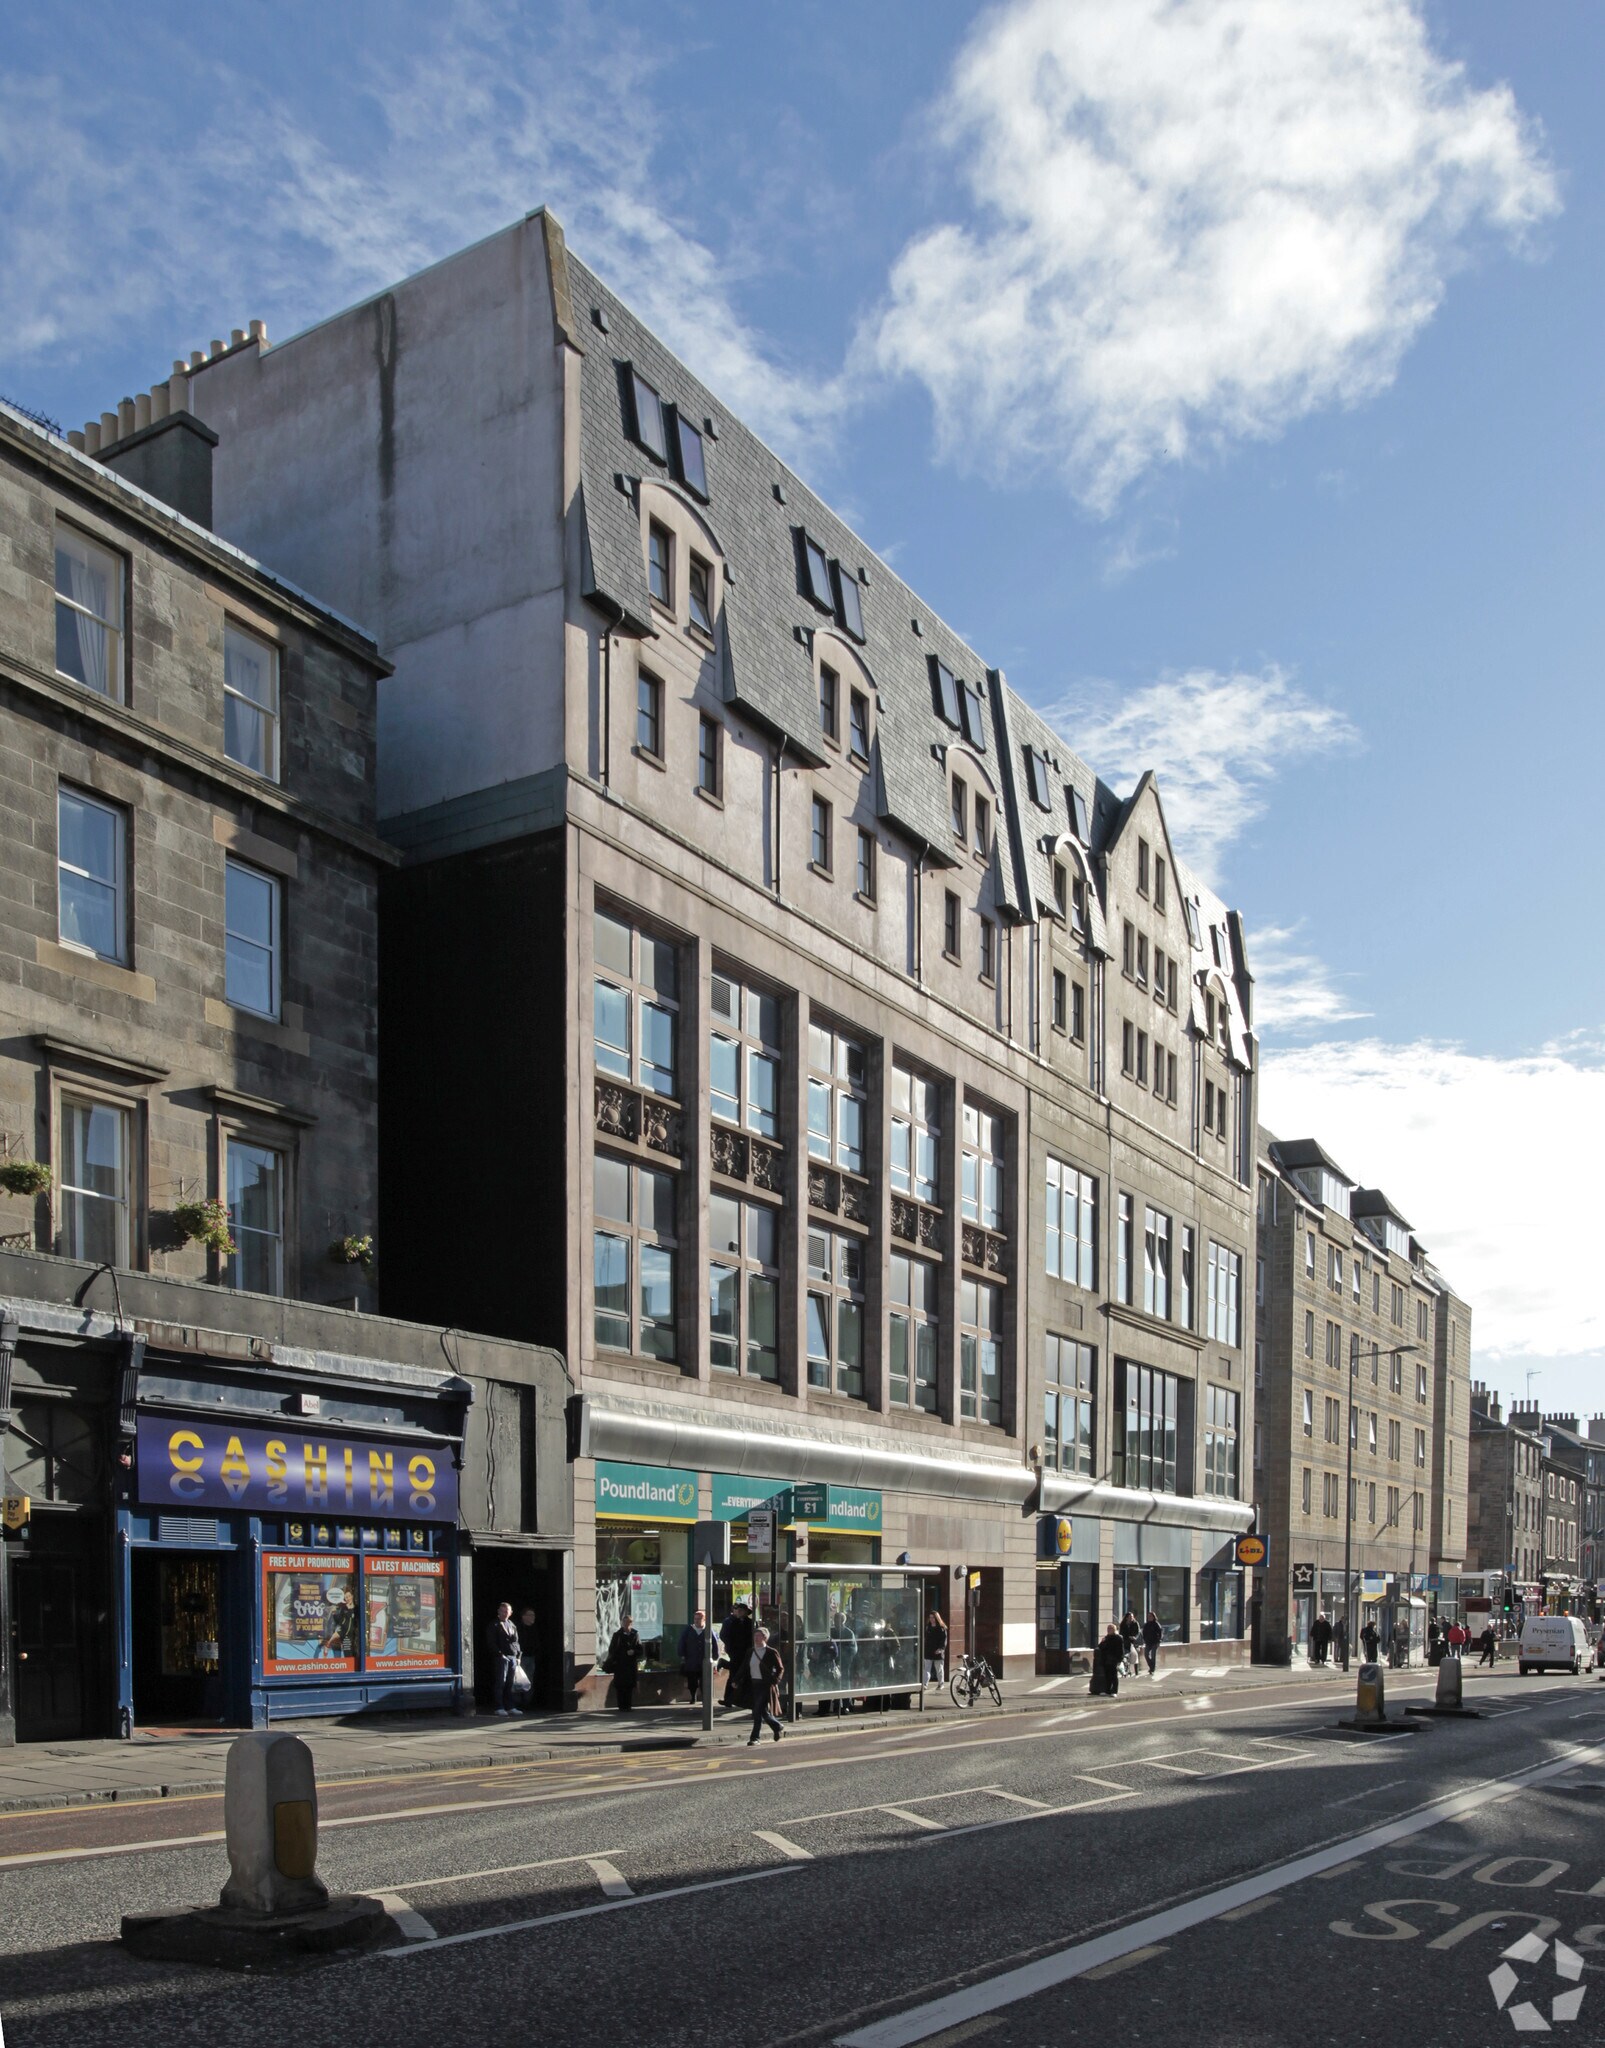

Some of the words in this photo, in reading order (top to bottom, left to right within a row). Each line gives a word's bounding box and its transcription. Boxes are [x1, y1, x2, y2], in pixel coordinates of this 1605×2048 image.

[303, 1400, 319, 1409] Abel
[168, 1429, 436, 1492] CASHINO
[600, 1477, 676, 1502] Poundland
[772, 1494, 785, 1511] £1
[804, 1502, 817, 1514] £1
[829, 1500, 866, 1518] ndland
[289, 1522, 425, 1543] GAMING
[269, 1556, 287, 1567] FREE
[288, 1557, 305, 1568] PLAY
[307, 1557, 350, 1569] PROMOTIONS
[371, 1560, 400, 1572] LATEST
[401, 1562, 441, 1573] MACHINES
[635, 1601, 658, 1622] £30
[1532, 1627, 1565, 1635] Prysmian
[275, 1661, 347, 1672] www.cashino.com
[375, 1658, 439, 1668] www.cashino.com
